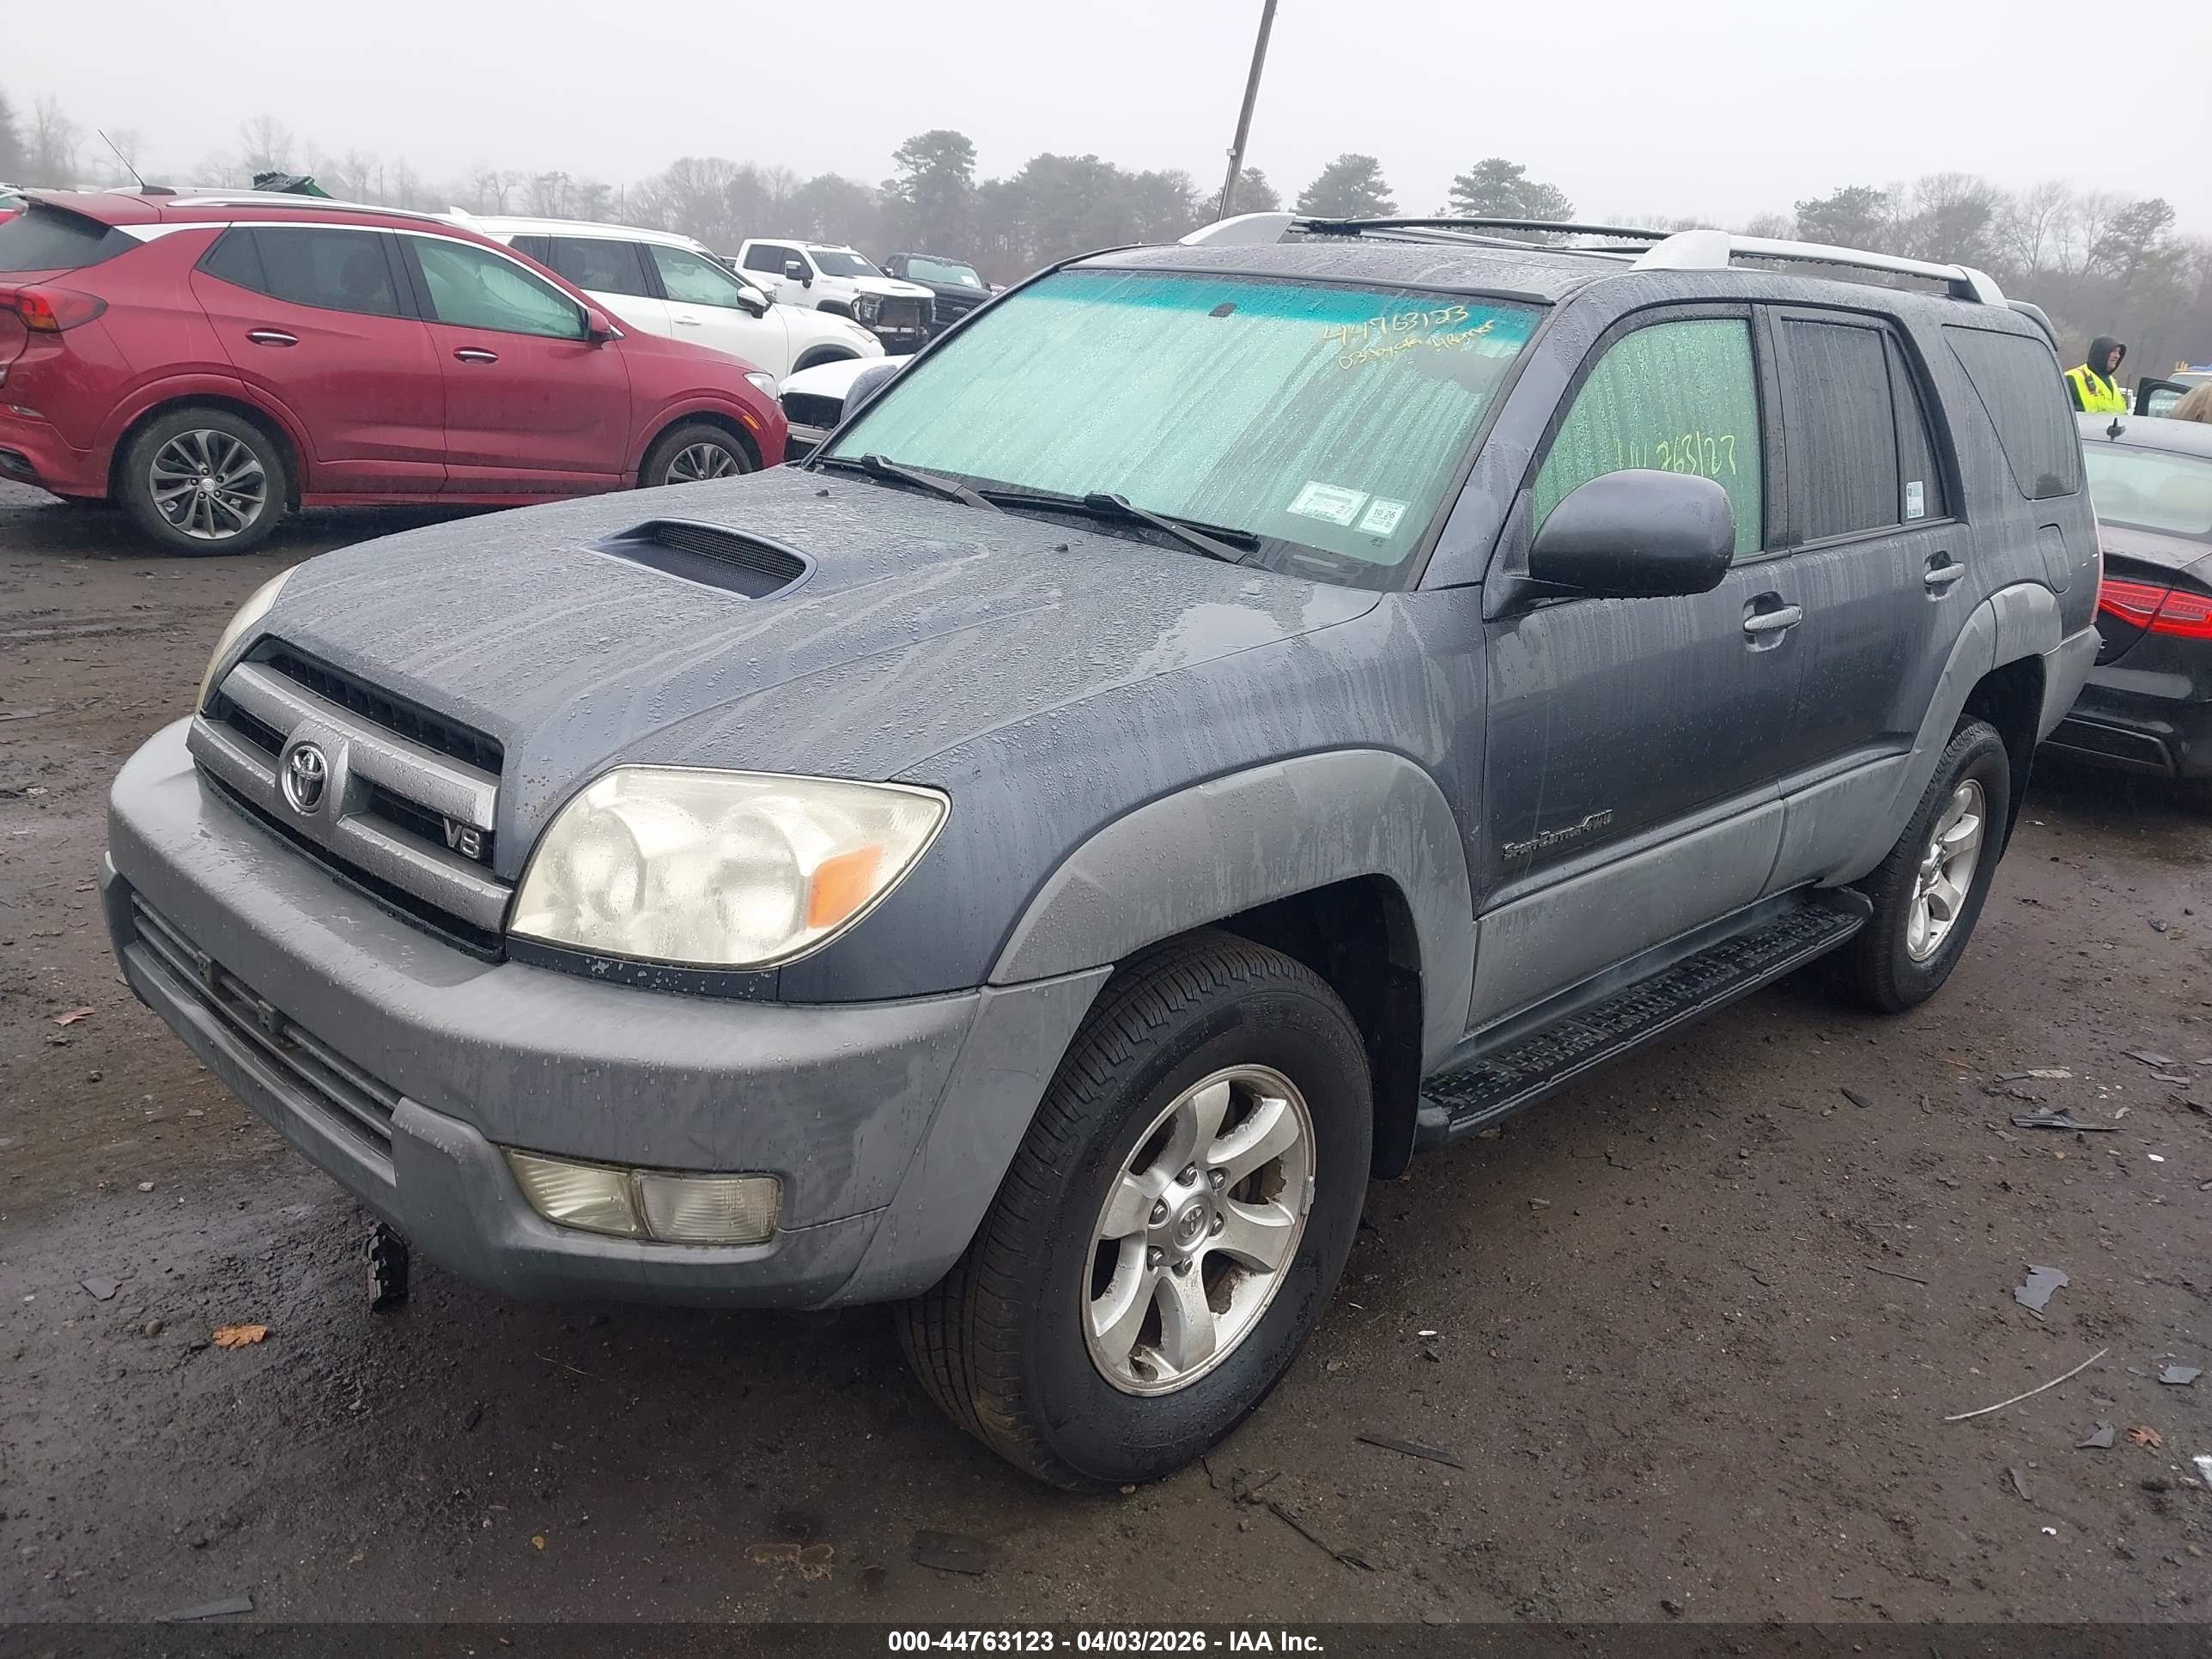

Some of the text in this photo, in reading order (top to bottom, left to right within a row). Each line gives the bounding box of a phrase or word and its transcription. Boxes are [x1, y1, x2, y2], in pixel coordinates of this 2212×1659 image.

[1323, 306, 1469, 345] 44763123
[1335, 505, 1354, 515] 27
[1373, 507, 1384, 516] 10
[443, 817, 481, 859] V8
